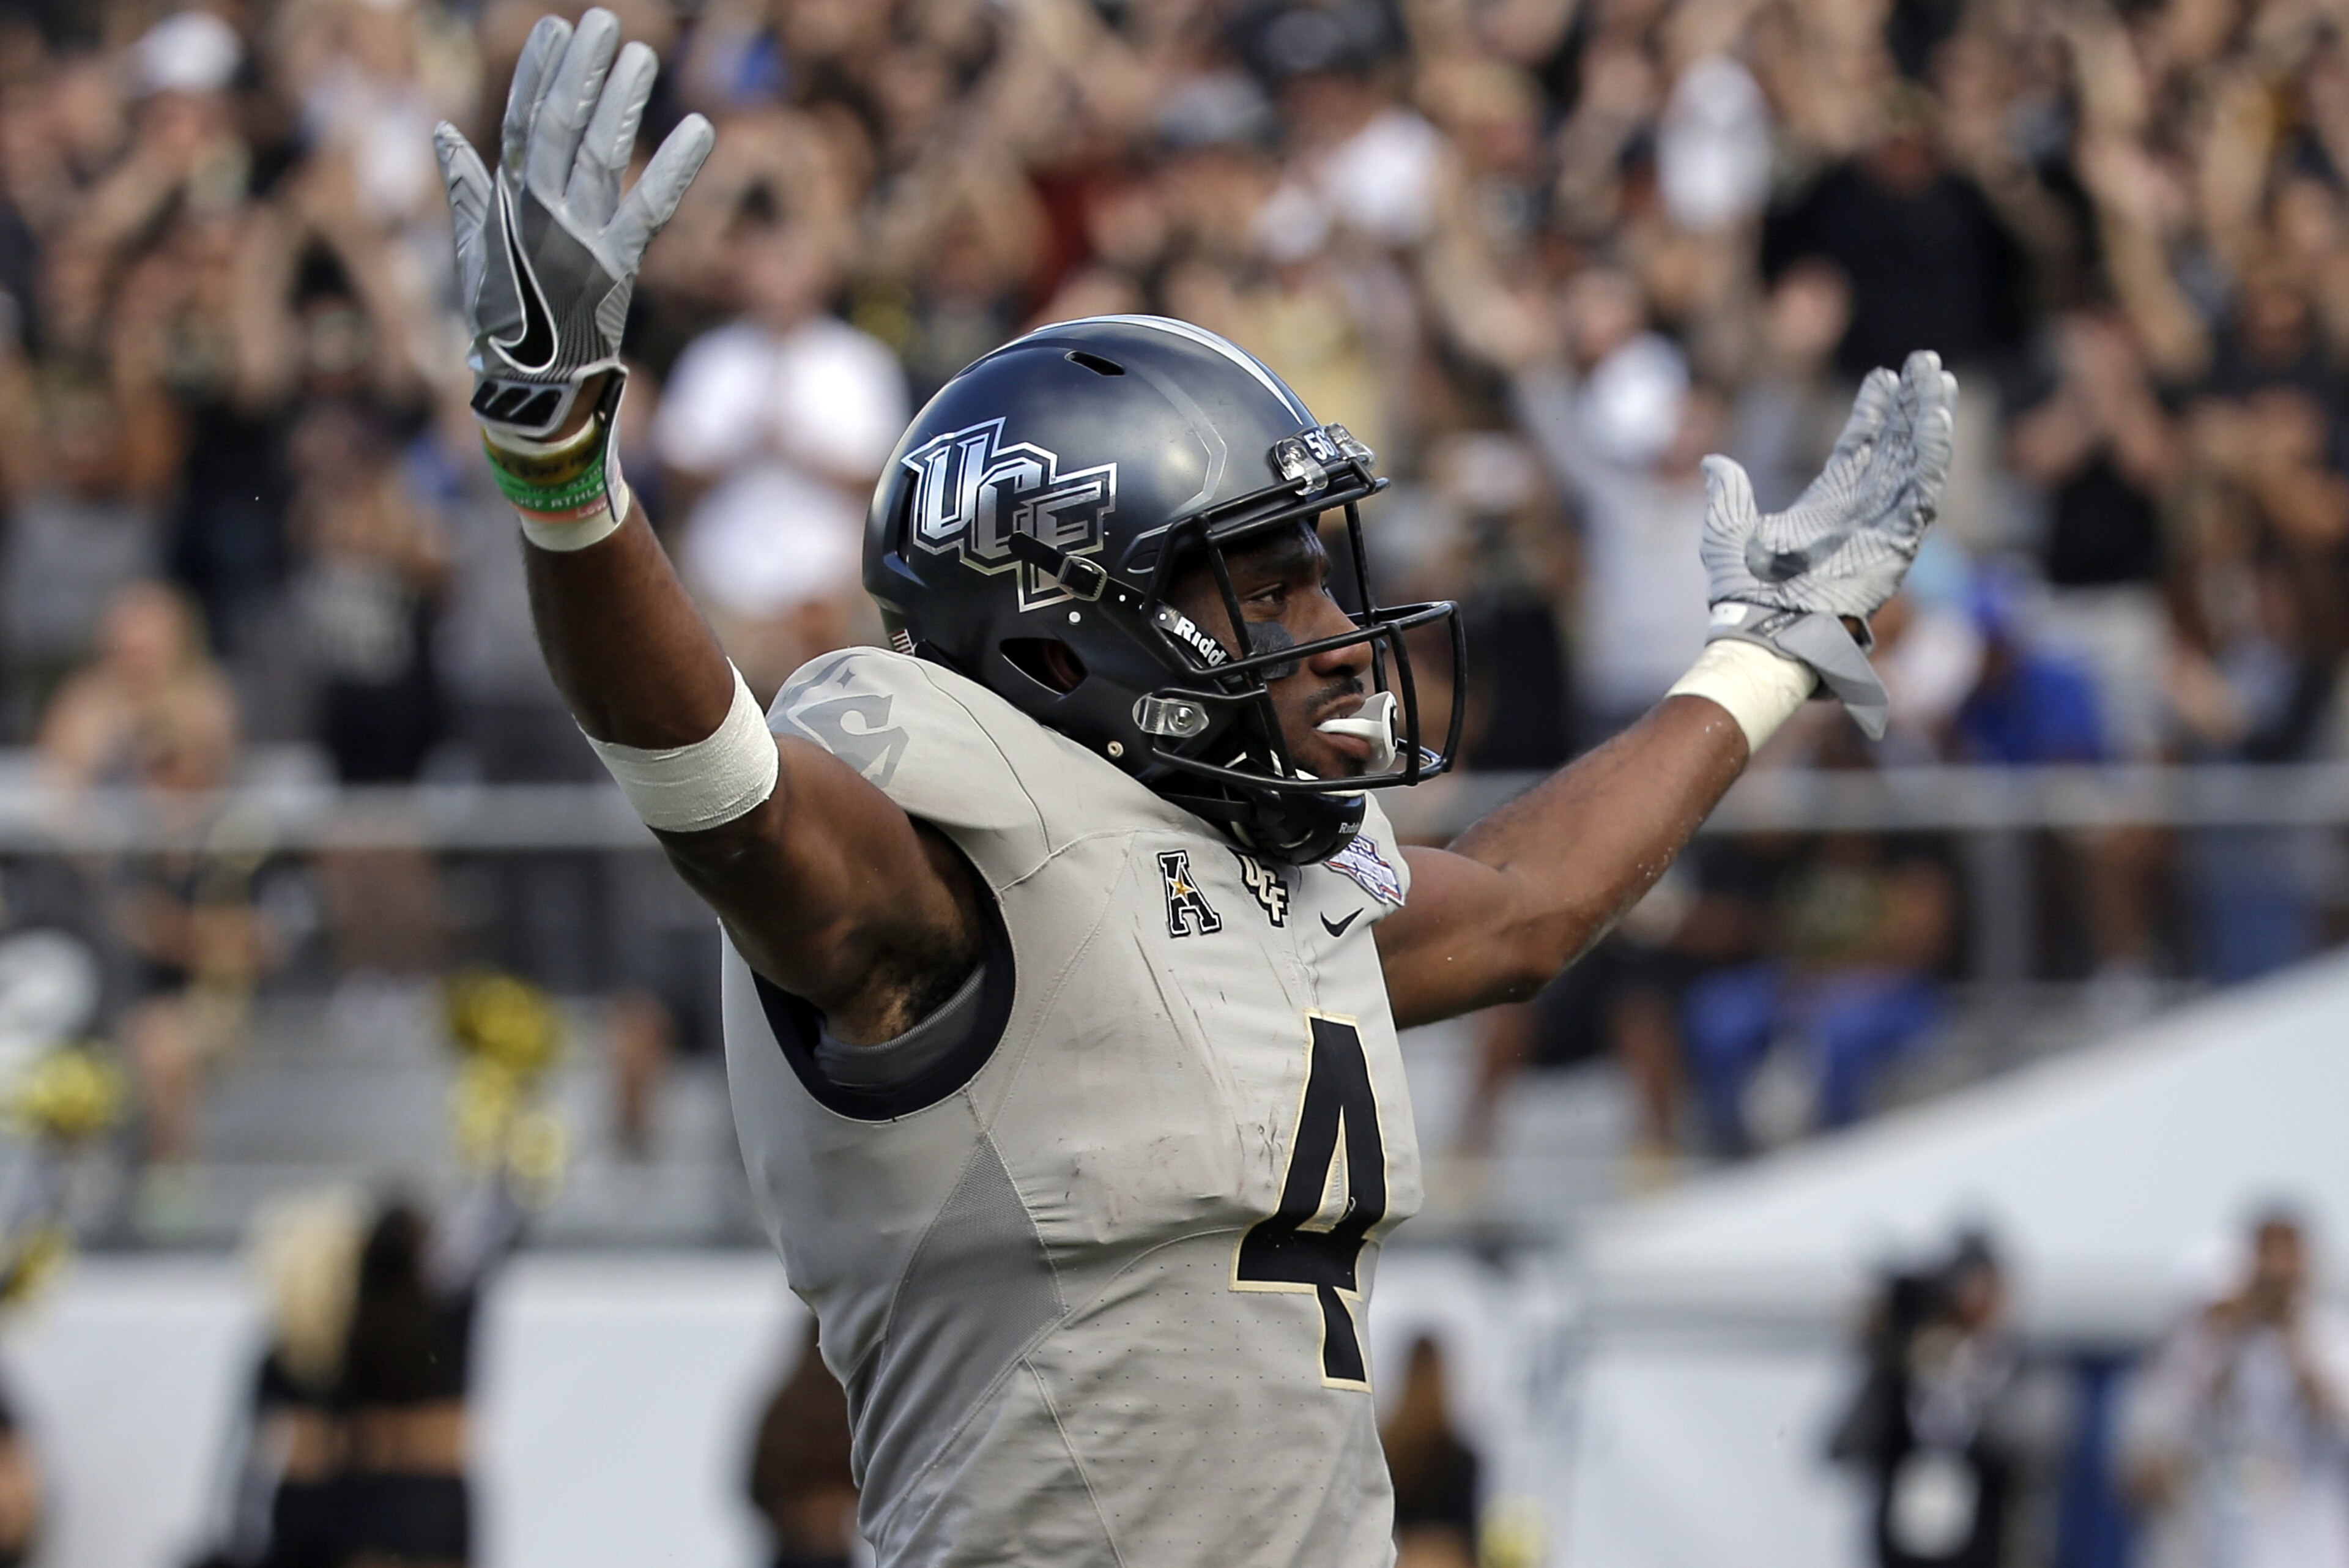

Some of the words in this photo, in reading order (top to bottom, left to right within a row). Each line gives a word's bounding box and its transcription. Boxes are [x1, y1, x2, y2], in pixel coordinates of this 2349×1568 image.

[551, 480, 604, 508] ATHLE
[902, 418, 1117, 612] UCF
[1174, 616, 1227, 667] Ridd
[1338, 822, 1360, 833] Ridd
[1157, 850, 1222, 938] A
[1232, 849, 1289, 927] UCF
[1228, 1007, 1385, 1392] 4
